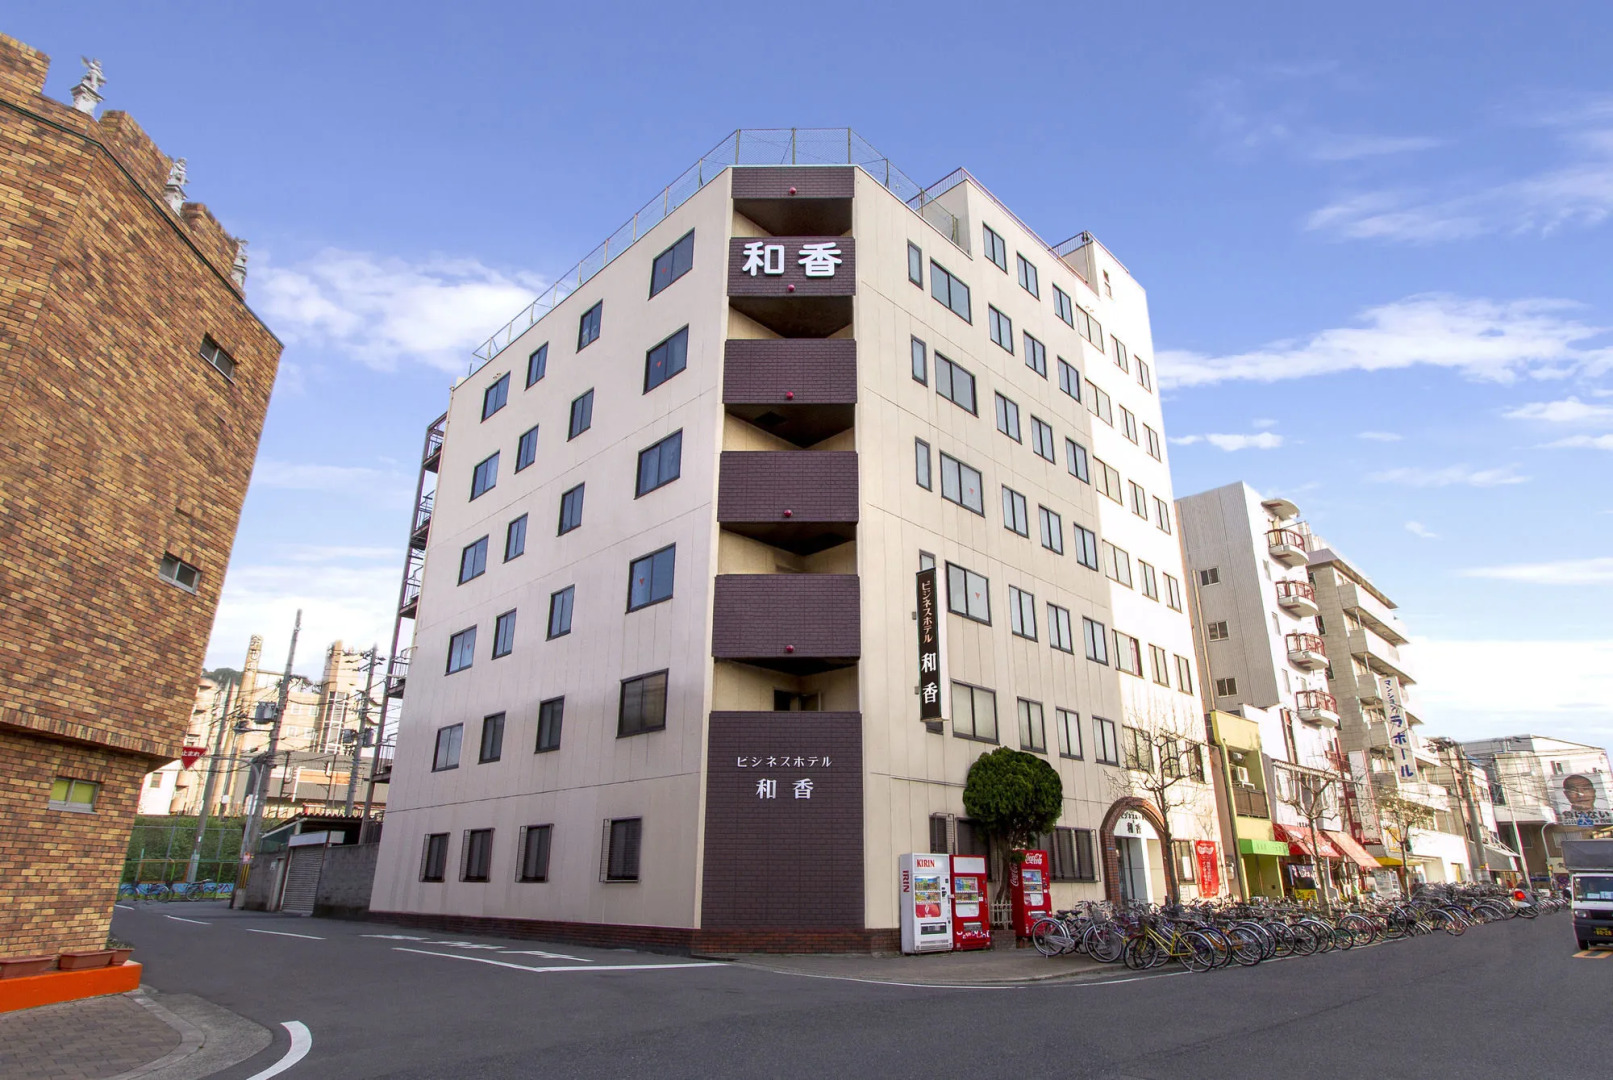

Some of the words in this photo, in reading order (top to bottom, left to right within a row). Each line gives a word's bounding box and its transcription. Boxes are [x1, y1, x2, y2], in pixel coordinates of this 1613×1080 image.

[742, 241, 843, 277] 和香
[921, 580, 933, 644] ビジネスホテル
[921, 652, 938, 704] 和香
[737, 756, 832, 768] ビジネスホテル
[756, 778, 814, 800] 和香
[916, 859, 935, 868] KIRIN
